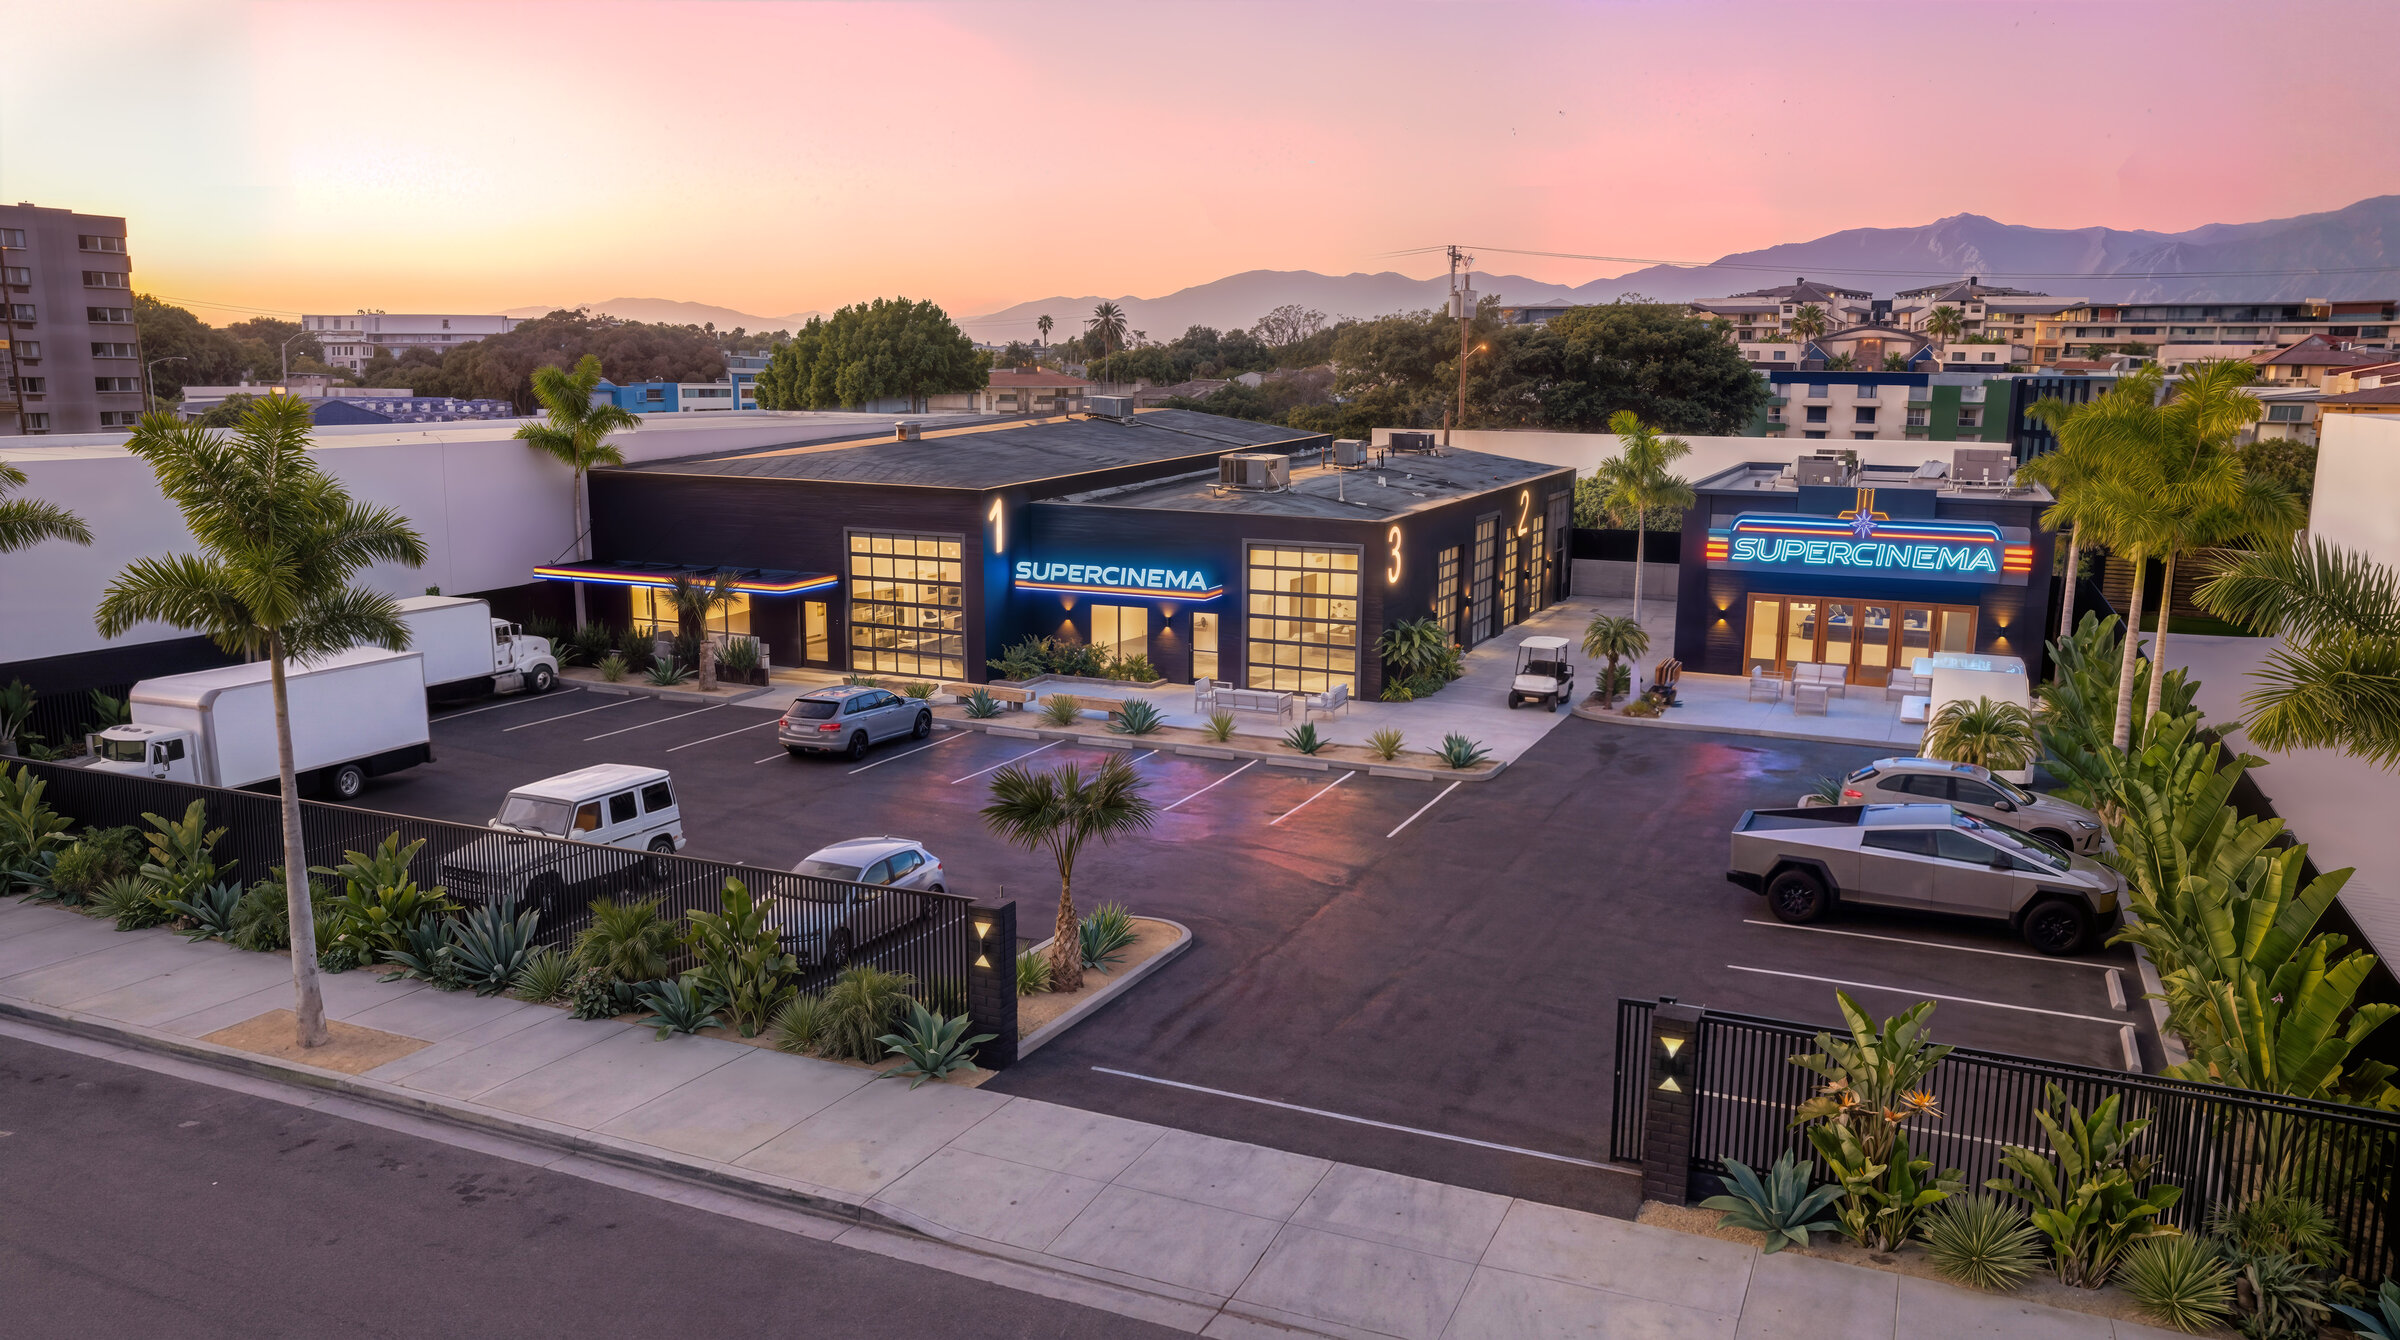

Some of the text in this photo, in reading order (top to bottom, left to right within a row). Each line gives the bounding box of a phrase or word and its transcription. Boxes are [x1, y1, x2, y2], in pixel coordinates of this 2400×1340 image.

[988, 498, 1003, 554] 1
[1518, 489, 1530, 537] 2
[1015, 561, 1208, 591] SUPERCINEMA
[1388, 525, 1402, 584] 3
[1731, 537, 1997, 572] SUPERCINEMA
